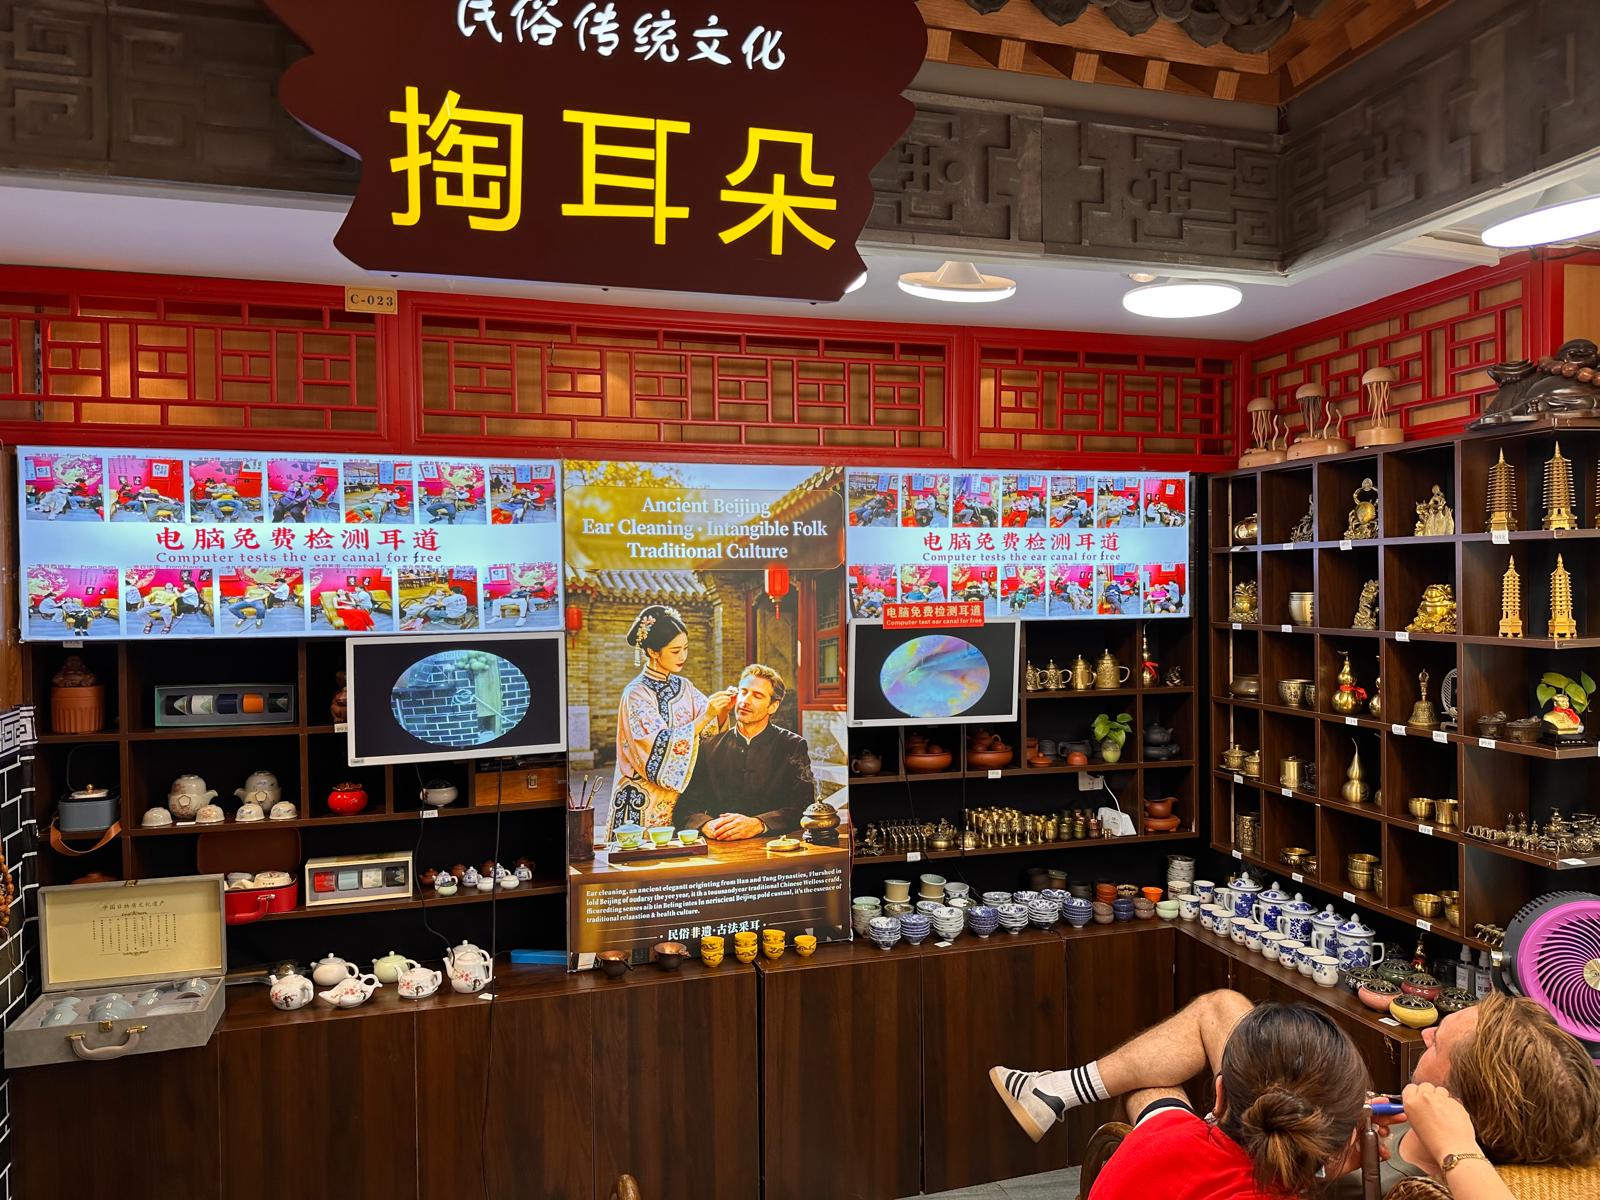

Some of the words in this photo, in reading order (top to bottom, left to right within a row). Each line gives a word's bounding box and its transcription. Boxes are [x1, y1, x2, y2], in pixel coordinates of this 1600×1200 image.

[457, 0, 786, 71] 民俗传统文化
[389, 86, 838, 256] 掏耳朵
[350, 293, 393, 306] C-023
[641, 496, 709, 513] Ancient
[712, 498, 770, 518] Beijing
[582, 518, 612, 535] Ear
[617, 518, 695, 539] Cleaning
[706, 520, 789, 539] Intangible
[792, 520, 828, 537] Folk
[155, 526, 441, 552] 电脑免费检测耳道
[922, 531, 1121, 551] 电脑免费检测耳道
[156, 552, 234, 565] Computer
[240, 552, 277, 563] tests
[283, 552, 307, 563] the
[313, 553, 336, 563] ear
[342, 552, 380, 563] canal
[387, 552, 409, 563] for
[412, 551, 442, 564] free
[627, 542, 722, 559] Traditional
[726, 543, 789, 559] Culture
[922, 552, 977, 563] Computer
[980, 552, 1006, 561] tests
[1010, 552, 1028, 561] the
[1031, 553, 1047, 561] ear
[1050, 552, 1078, 561] canal
[1081, 551, 1097, 561] for
[1100, 550, 1121, 561] free
[886, 604, 982, 618] 电脑免费检测耳道
[886, 619, 918, 627] Computer
[598, 887, 628, 897] cleaning,
[637, 885, 662, 893] ancient
[736, 877, 750, 885] Han
[762, 874, 777, 882] Tang
[777, 872, 808, 881] Dynasties,
[600, 896, 621, 906] Beijing
[675, 892, 690, 900] year,
[748, 882, 779, 892] traditional
[779, 880, 802, 888] Chinese
[735, 892, 757, 902] Beijing
[812, 885, 835, 893] essence
[586, 914, 619, 923] traditional
[656, 909, 676, 918] health
[676, 907, 700, 916] culture.
